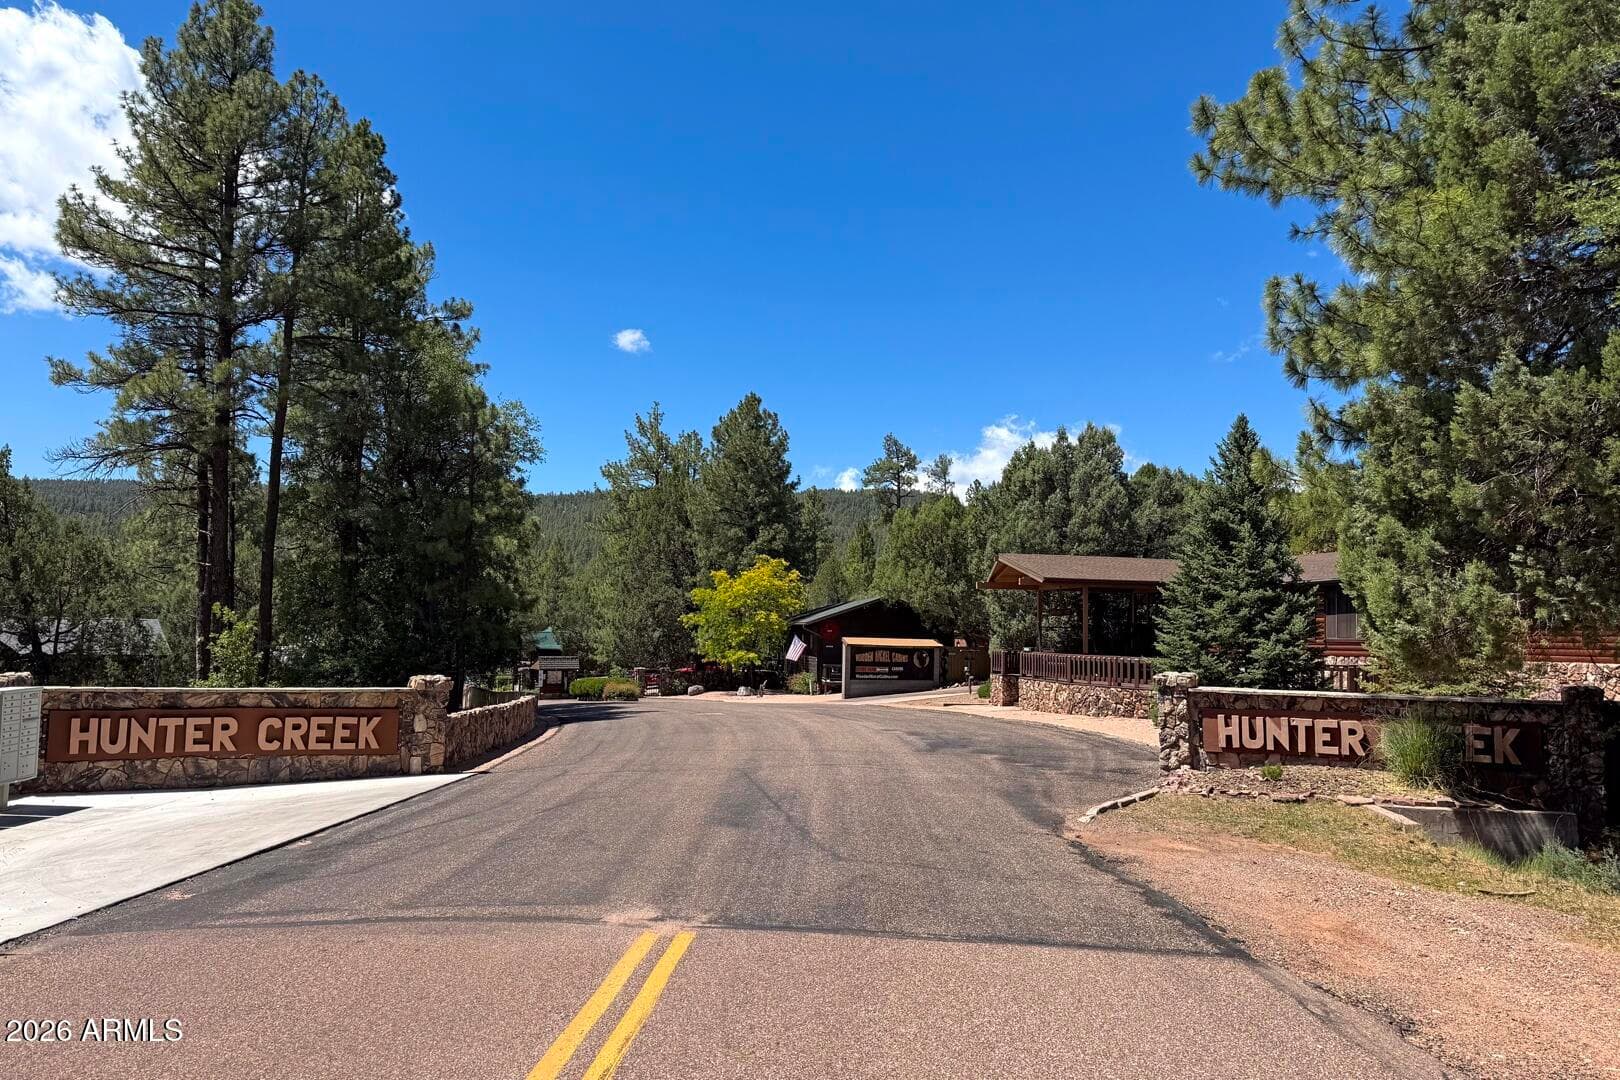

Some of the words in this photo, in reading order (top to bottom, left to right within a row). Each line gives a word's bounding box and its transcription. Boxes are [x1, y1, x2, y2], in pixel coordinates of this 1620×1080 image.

[69, 717, 239, 755] HUNTER
[257, 716, 383, 751] CREEK
[1217, 714, 1366, 757] HUNTER
